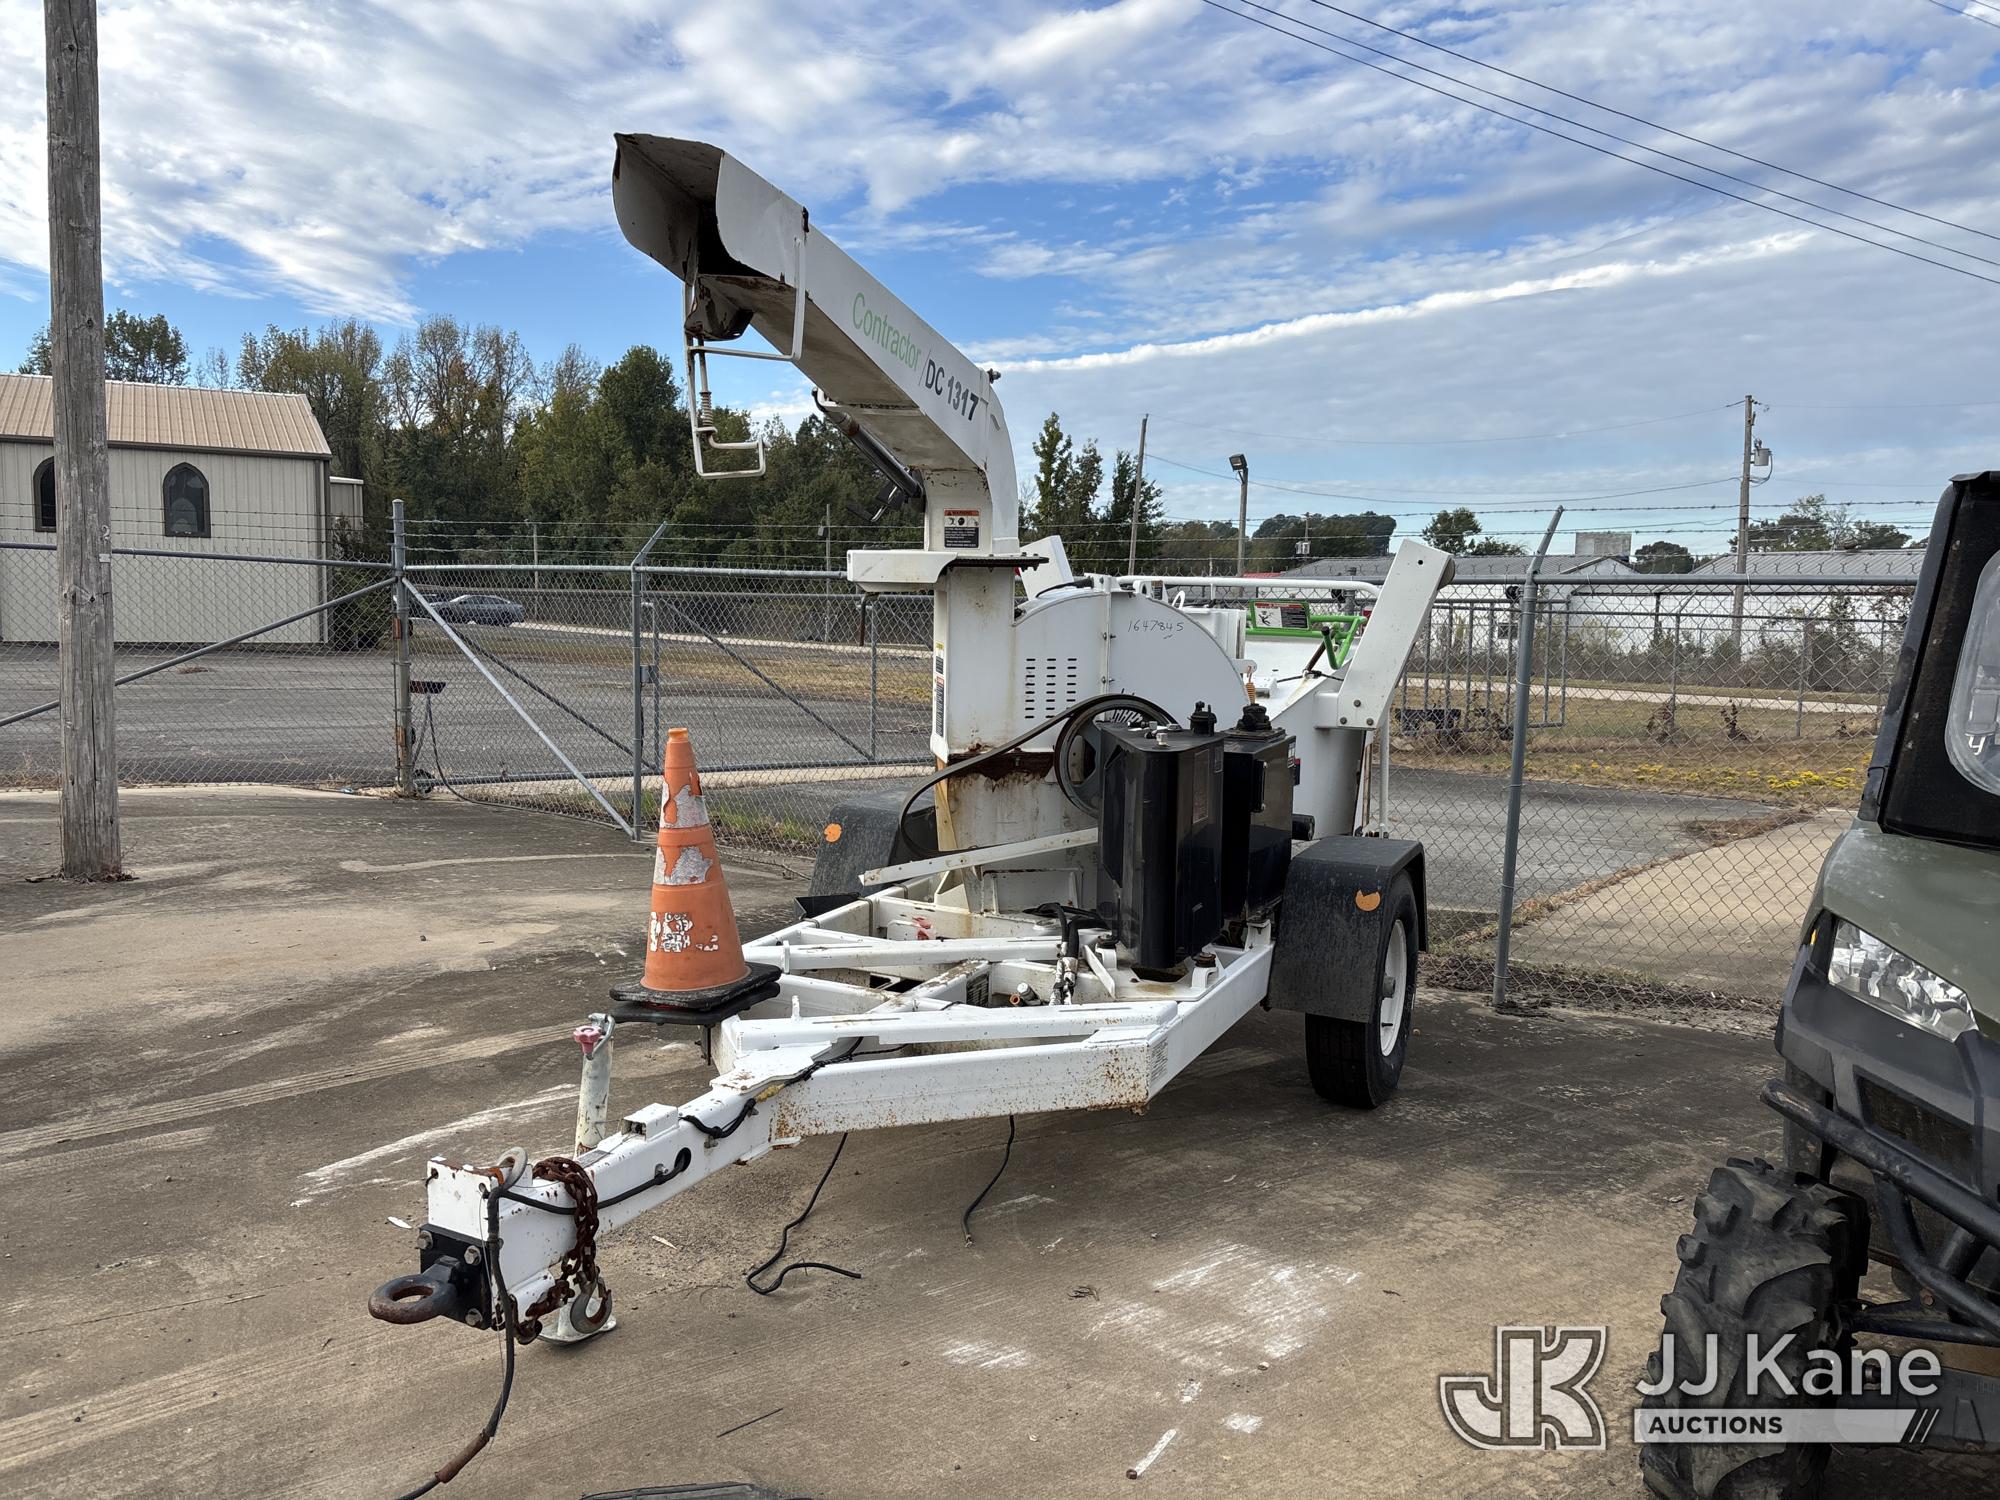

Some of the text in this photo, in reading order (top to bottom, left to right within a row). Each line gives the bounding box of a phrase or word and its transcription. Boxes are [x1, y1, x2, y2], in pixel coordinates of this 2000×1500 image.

[853, 292, 979, 421] Contractor DC 1317
[1128, 619, 1185, 632] 1647845
